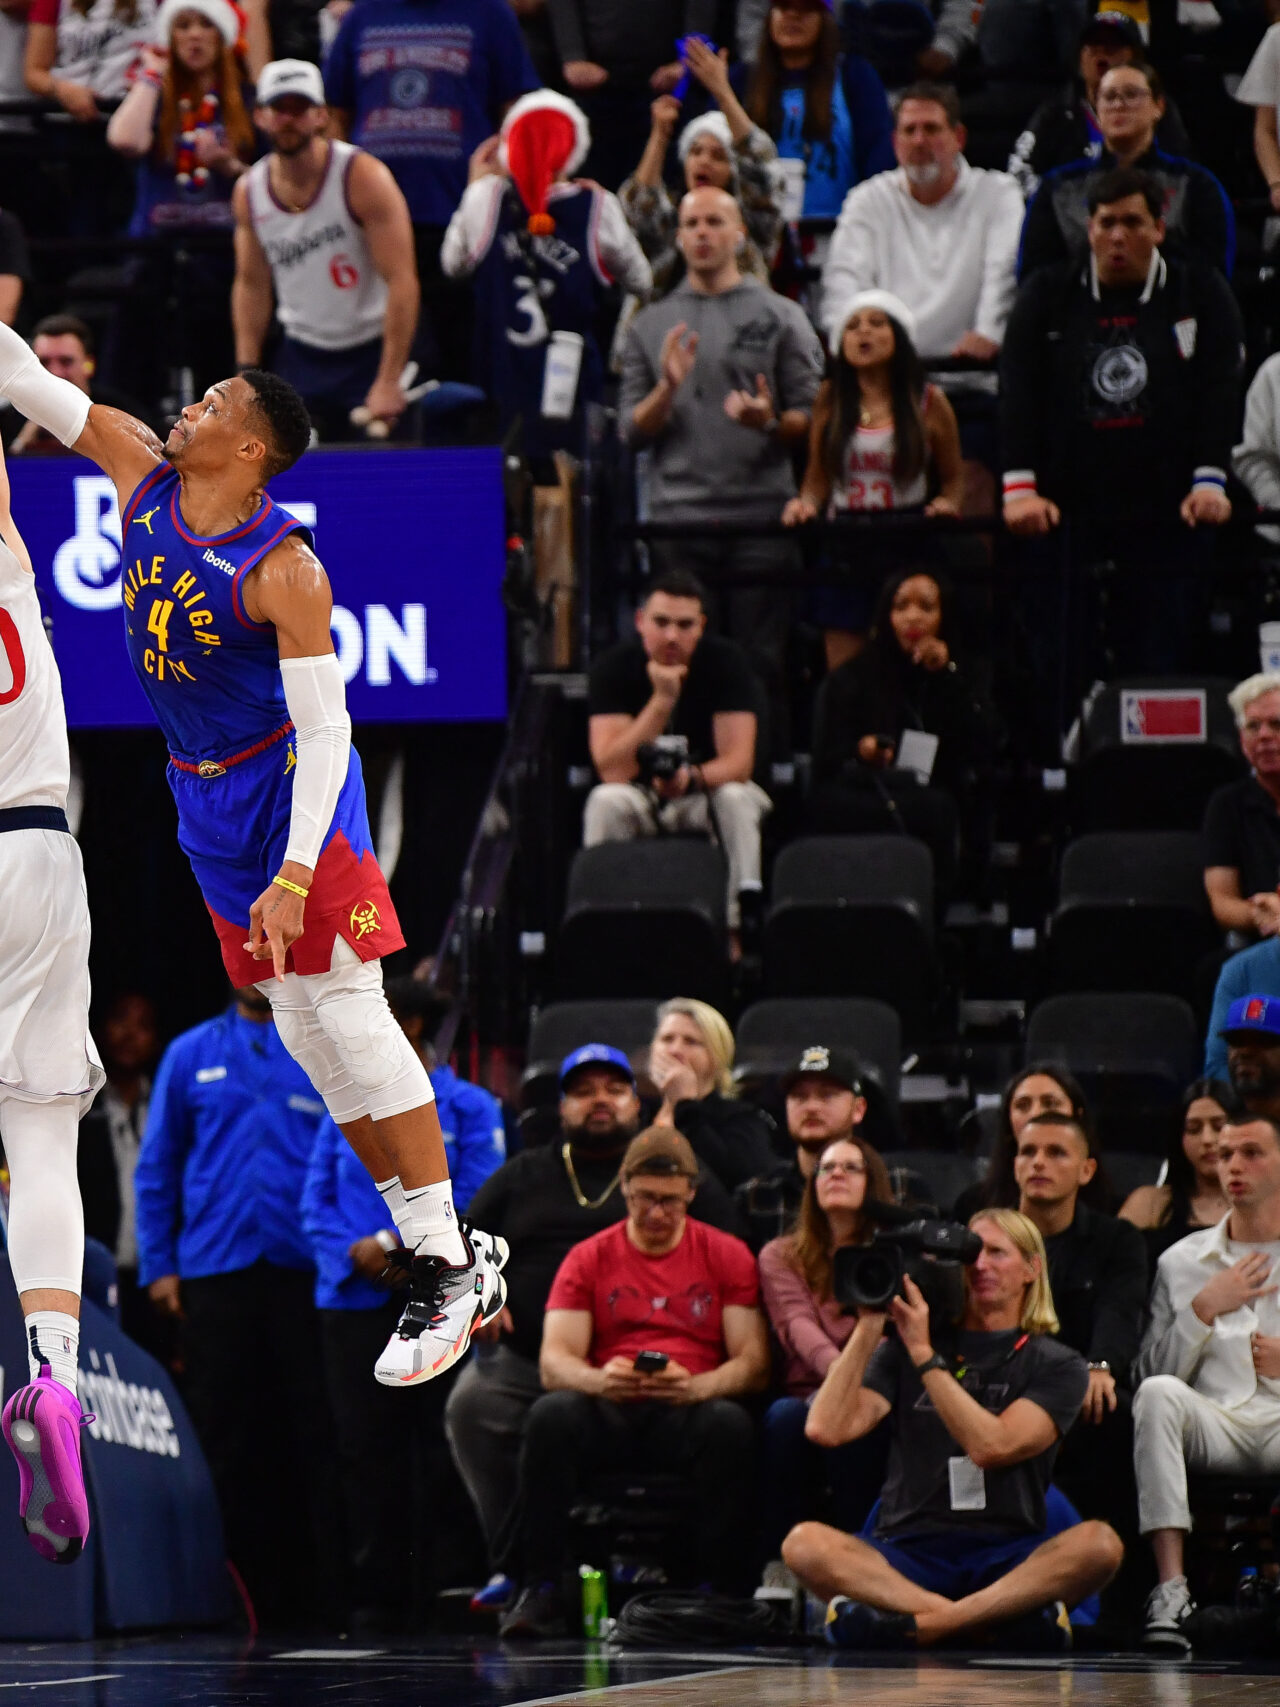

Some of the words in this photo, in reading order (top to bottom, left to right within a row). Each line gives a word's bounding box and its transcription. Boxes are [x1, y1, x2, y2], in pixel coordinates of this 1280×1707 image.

[329, 253, 359, 289] 6
[202, 548, 237, 576] ibotta
[124, 555, 166, 611] MILE
[172, 569, 221, 646] HIGH
[147, 599, 174, 652] 4
